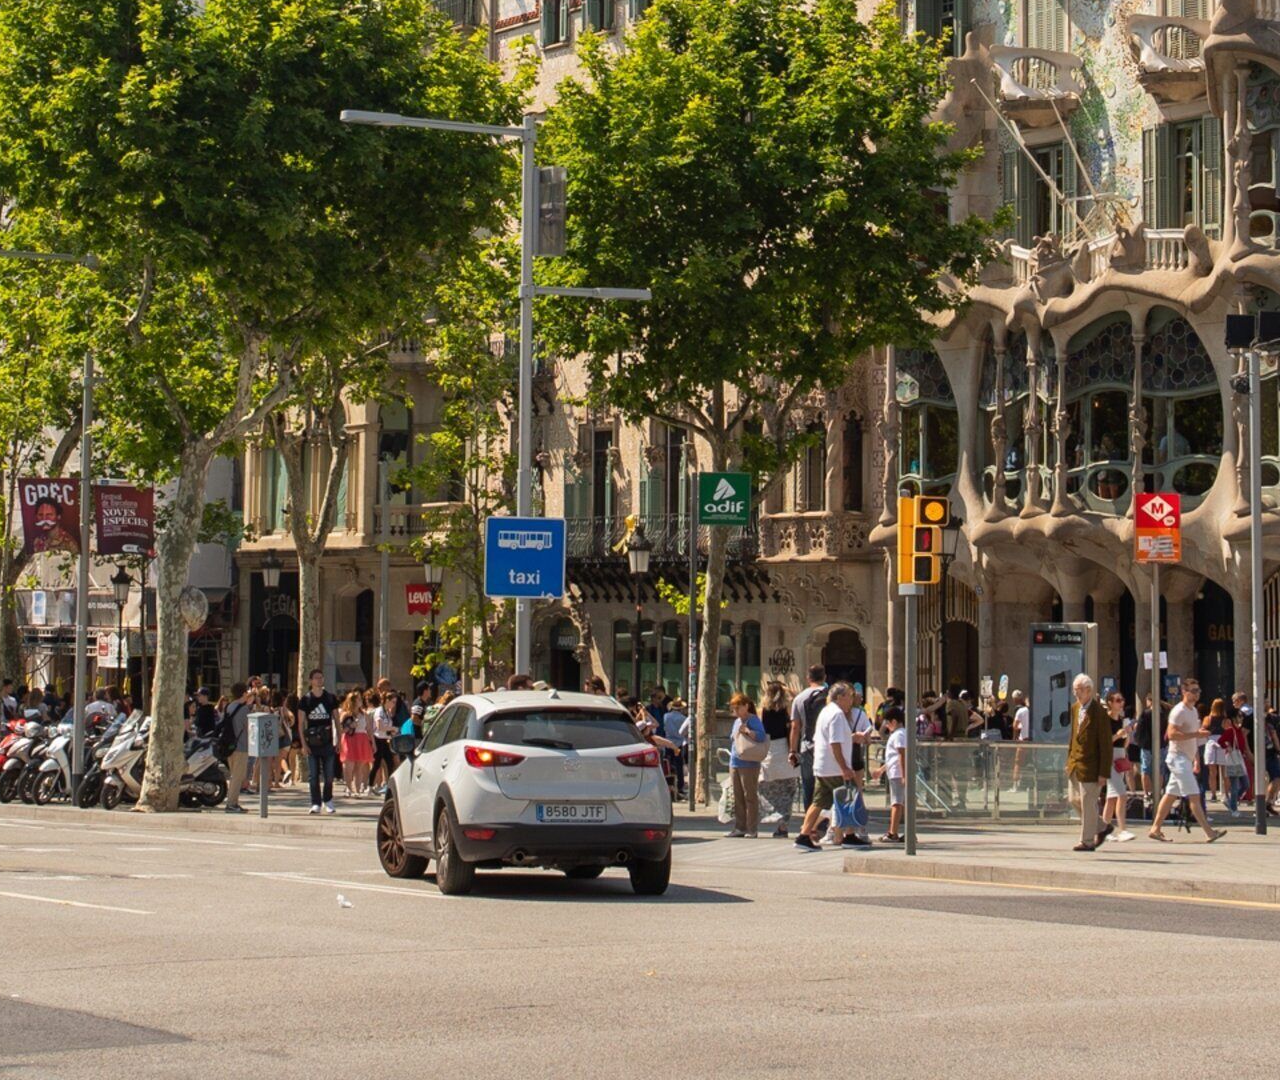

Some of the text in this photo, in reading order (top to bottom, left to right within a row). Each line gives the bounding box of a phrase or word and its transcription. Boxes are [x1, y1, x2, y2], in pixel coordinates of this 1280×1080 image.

[103, 508, 136, 517] NOVES
[704, 500, 745, 513] adif
[1152, 503, 1164, 514] M
[509, 569, 540, 584] taxi
[546, 806, 603, 818] 8580 JTF
